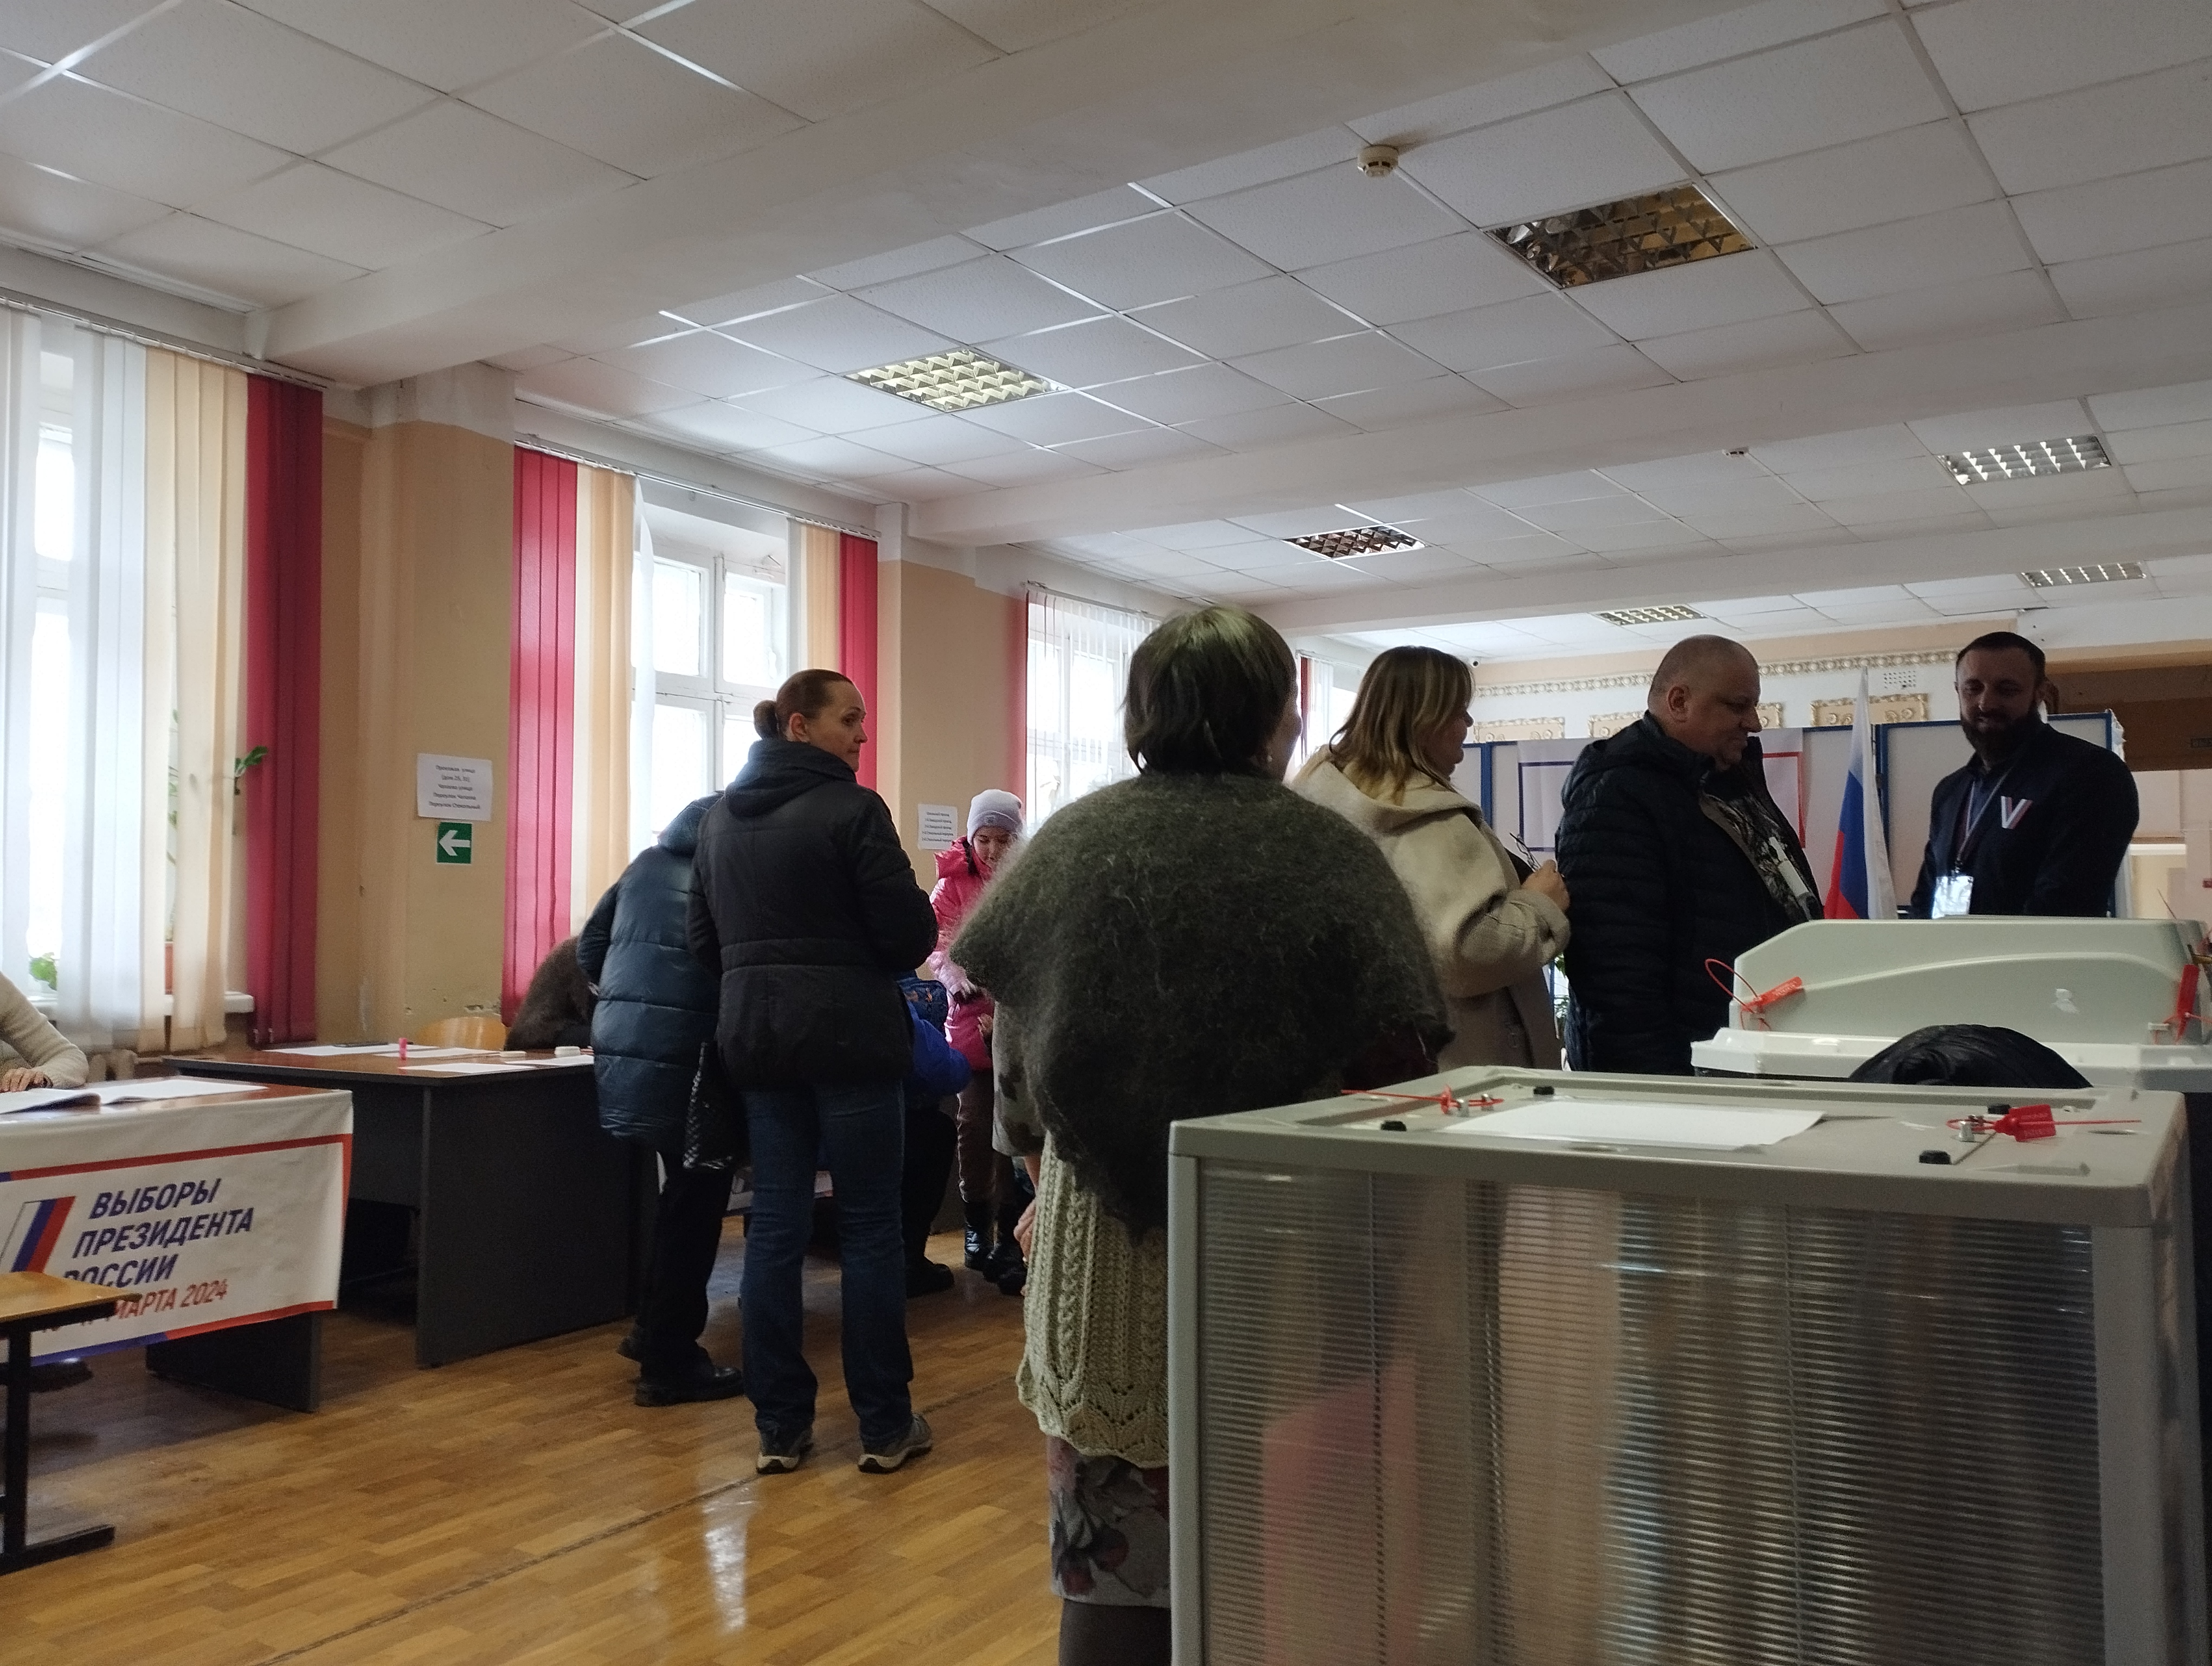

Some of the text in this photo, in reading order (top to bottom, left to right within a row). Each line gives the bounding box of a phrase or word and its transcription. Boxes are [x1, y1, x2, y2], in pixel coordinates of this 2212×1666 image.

[2001, 796, 2033, 829] V
[89, 1178, 222, 1219] ВЫБОРЫ
[72, 1207, 254, 1258] ПРЕЗИДЕНТА
